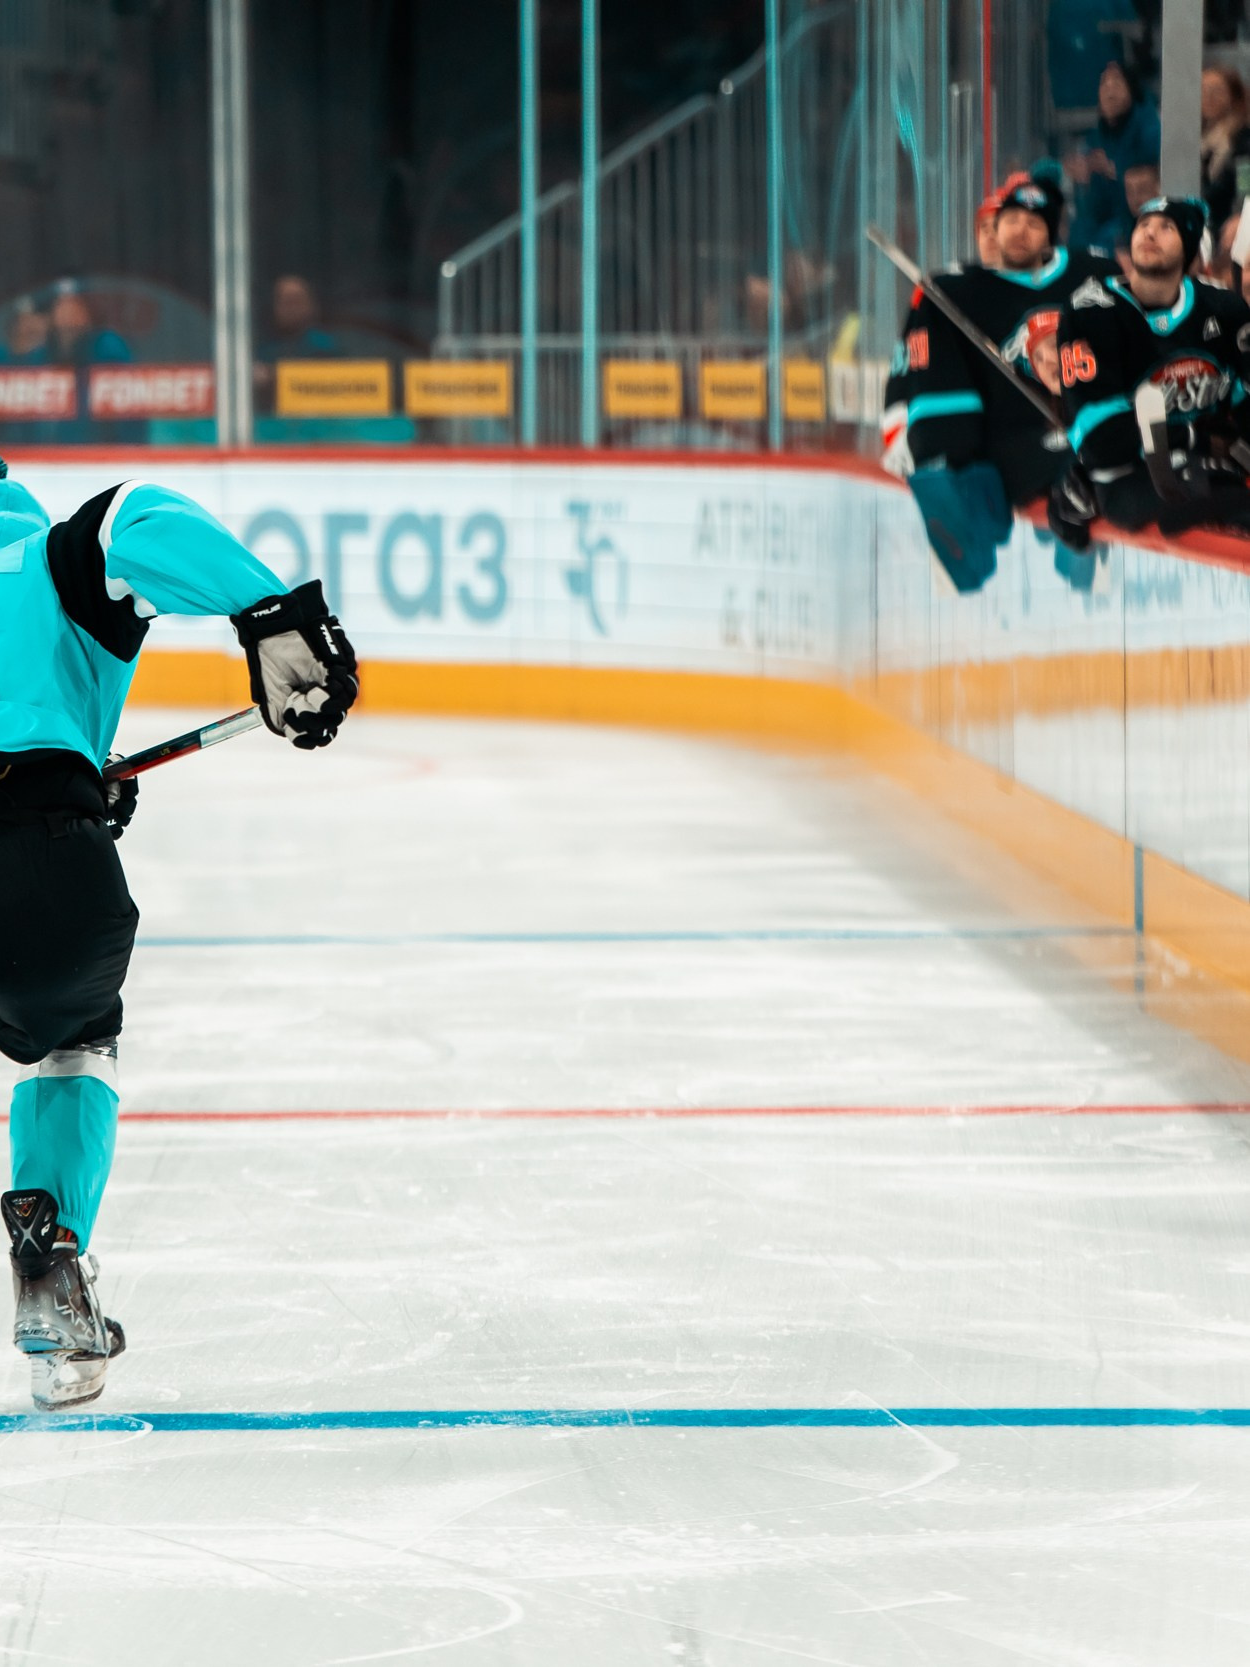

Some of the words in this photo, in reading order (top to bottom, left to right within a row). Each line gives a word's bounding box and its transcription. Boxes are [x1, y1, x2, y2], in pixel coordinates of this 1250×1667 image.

[91, 371, 212, 412] FONBET
[251, 603, 282, 618] TRUE
[320, 623, 339, 655] TRUE
